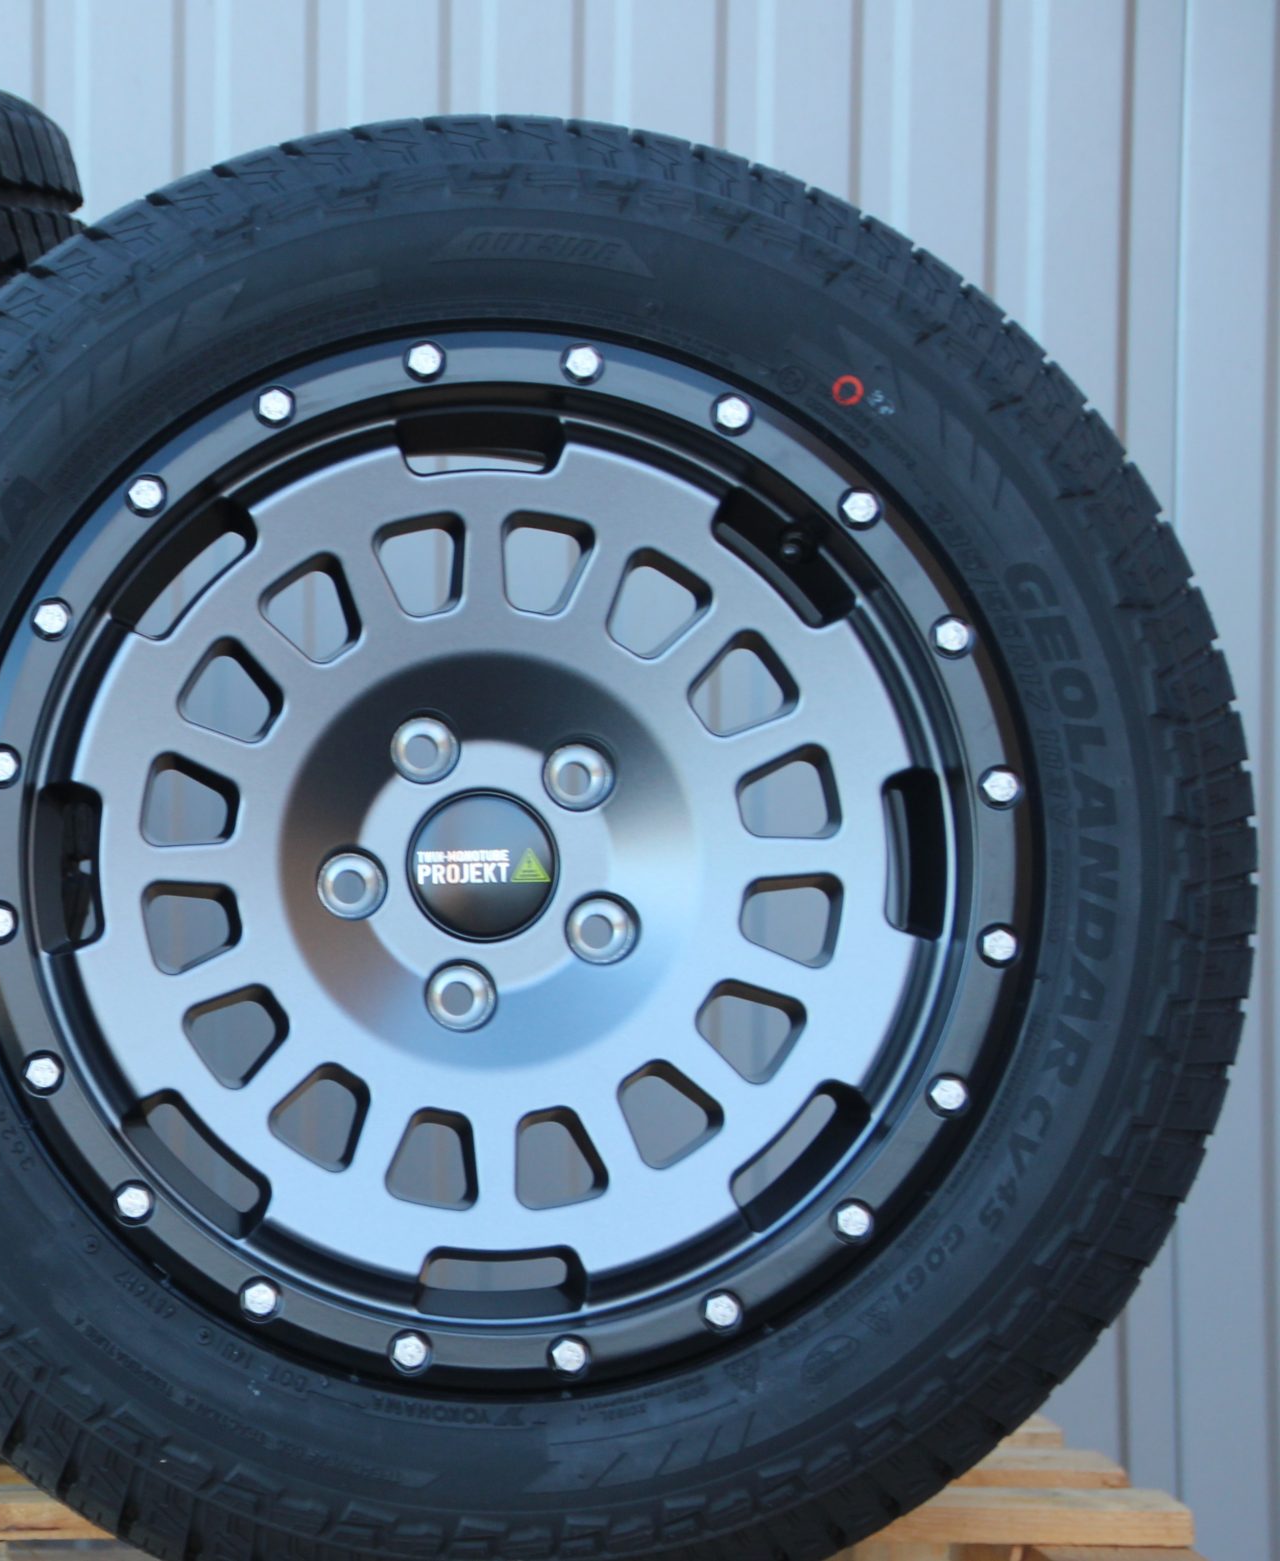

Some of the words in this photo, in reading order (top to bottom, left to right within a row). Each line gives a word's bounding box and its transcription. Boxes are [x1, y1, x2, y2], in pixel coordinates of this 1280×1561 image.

[466, 232, 621, 266] OUTSIDE
[1003, 561, 1120, 1088] GEOLANDAR
[417, 862, 510, 885] PROJEKT
[366, 1392, 489, 1425] YOKOHAMA
